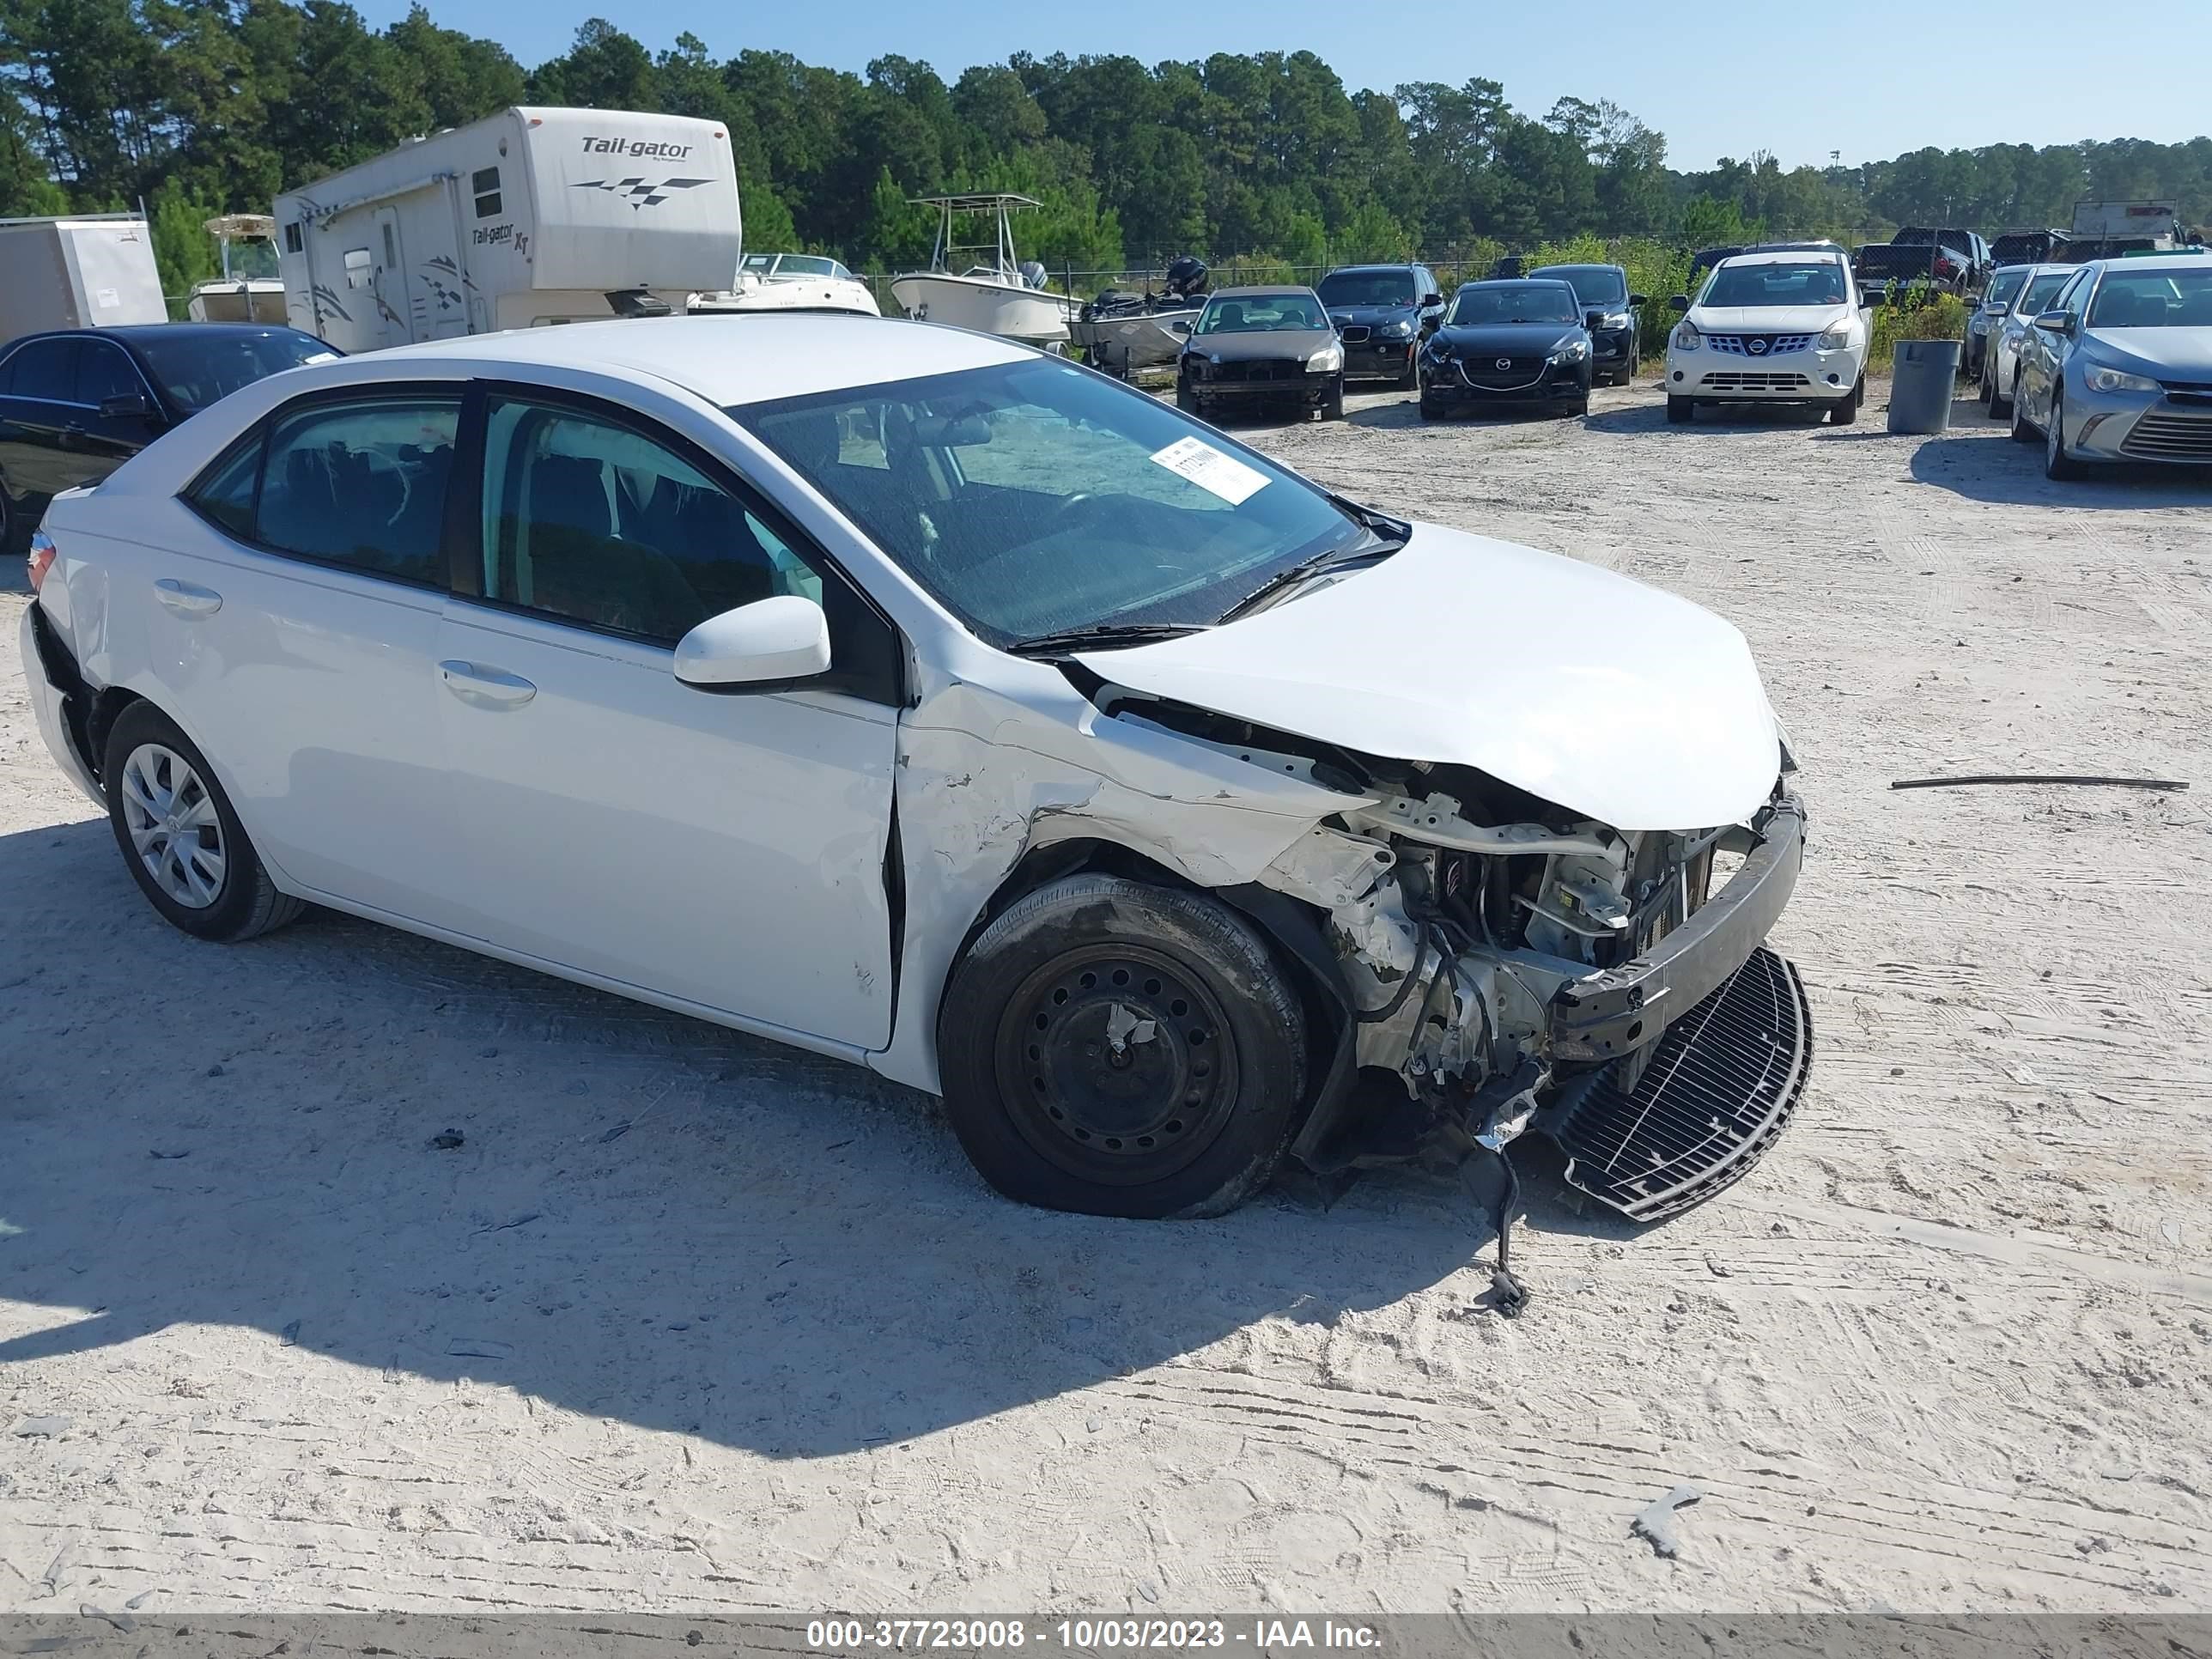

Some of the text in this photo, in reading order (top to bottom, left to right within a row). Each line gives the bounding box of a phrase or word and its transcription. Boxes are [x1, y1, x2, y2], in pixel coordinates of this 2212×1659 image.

[582, 137, 692, 158] Tail-gator
[472, 223, 514, 245] Tail-gator
[514, 232, 529, 255] XT
